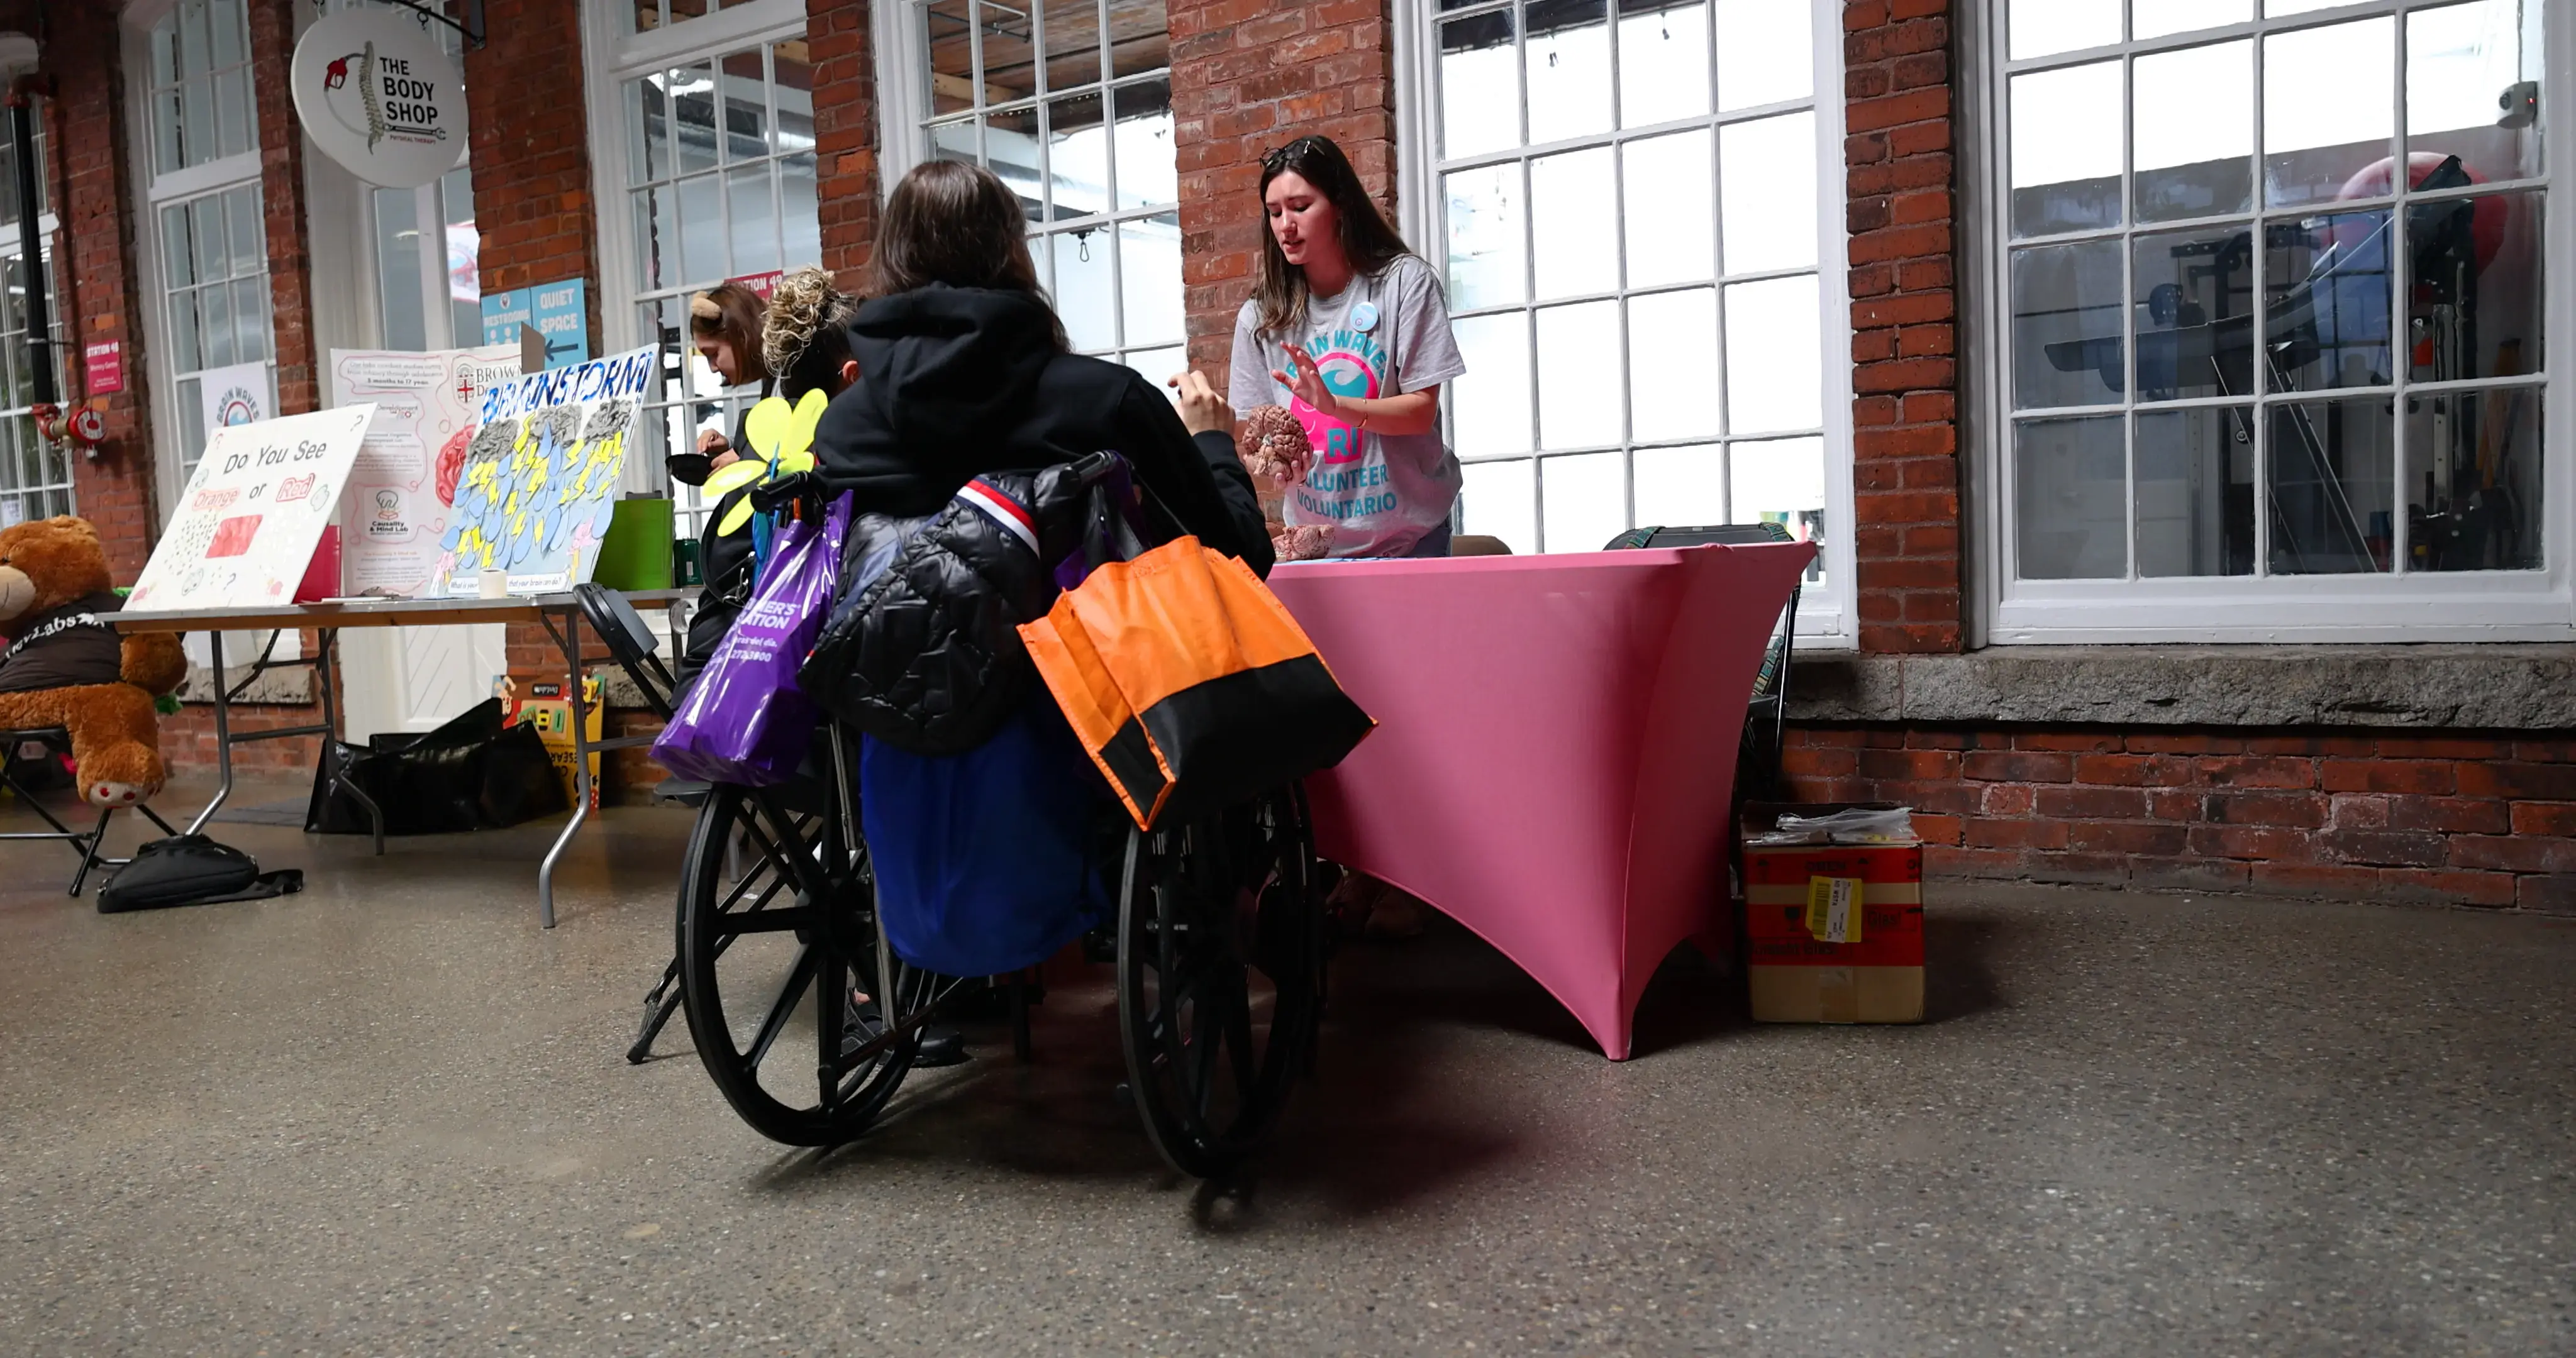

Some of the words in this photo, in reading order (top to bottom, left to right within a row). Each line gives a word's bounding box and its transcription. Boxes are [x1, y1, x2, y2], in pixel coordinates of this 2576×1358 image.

[379, 57, 410, 75] THE
[383, 77, 435, 101] BODY
[386, 101, 438, 124] SHOP
[414, 137, 436, 145] THERAPY
[769, 275, 782, 288] 49
[540, 288, 575, 309] QUIET
[484, 309, 530, 327] RESTROOMS
[540, 312, 578, 334] SPACE
[87, 344, 110, 358] STATION
[1280, 334, 1329, 391] RIN
[216, 387, 234, 424] BRAIN
[235, 386, 260, 421] WAVES
[1328, 427, 1357, 457] RI
[223, 454, 248, 475] Do
[257, 445, 288, 467] You
[294, 440, 326, 461] See
[1305, 464, 1389, 492] LUNTEER
[194, 490, 238, 509] Orange
[249, 483, 267, 499] or
[278, 475, 313, 500] Red
[1297, 489, 1397, 519] VOLUNTARIO
[450, 580, 462, 588] What
[509, 578, 518, 587] that
[518, 580, 530, 590] your
[530, 578, 542, 587] brain
[551, 751, 577, 764] ESEAR
